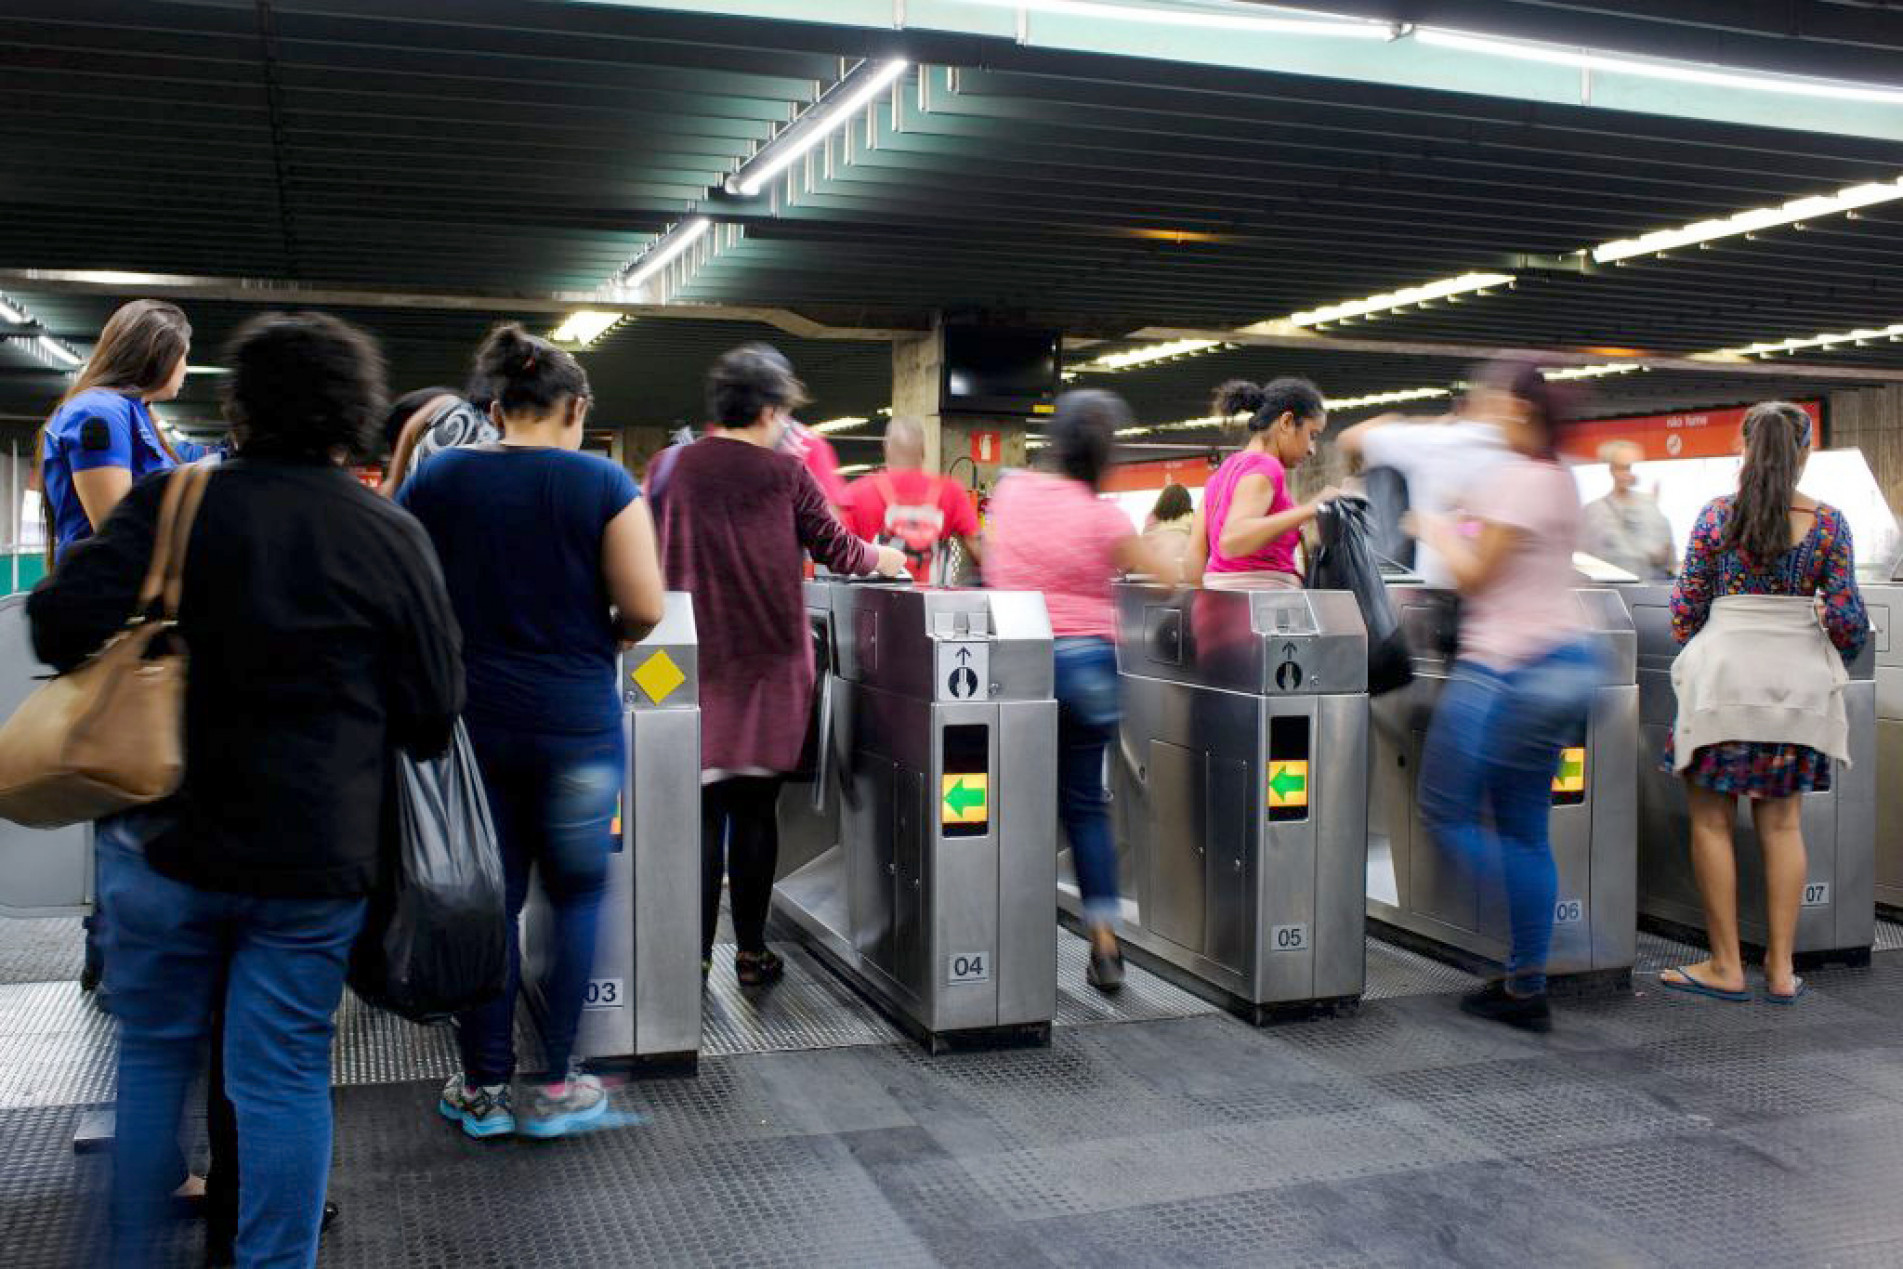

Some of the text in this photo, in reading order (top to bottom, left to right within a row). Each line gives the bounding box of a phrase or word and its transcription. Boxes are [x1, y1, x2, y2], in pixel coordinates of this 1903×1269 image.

[1805, 885, 1825, 903] 07
[1556, 902, 1578, 921] 06
[1278, 928, 1302, 947] 05
[954, 956, 983, 977] 04
[586, 982, 616, 1004] 03
